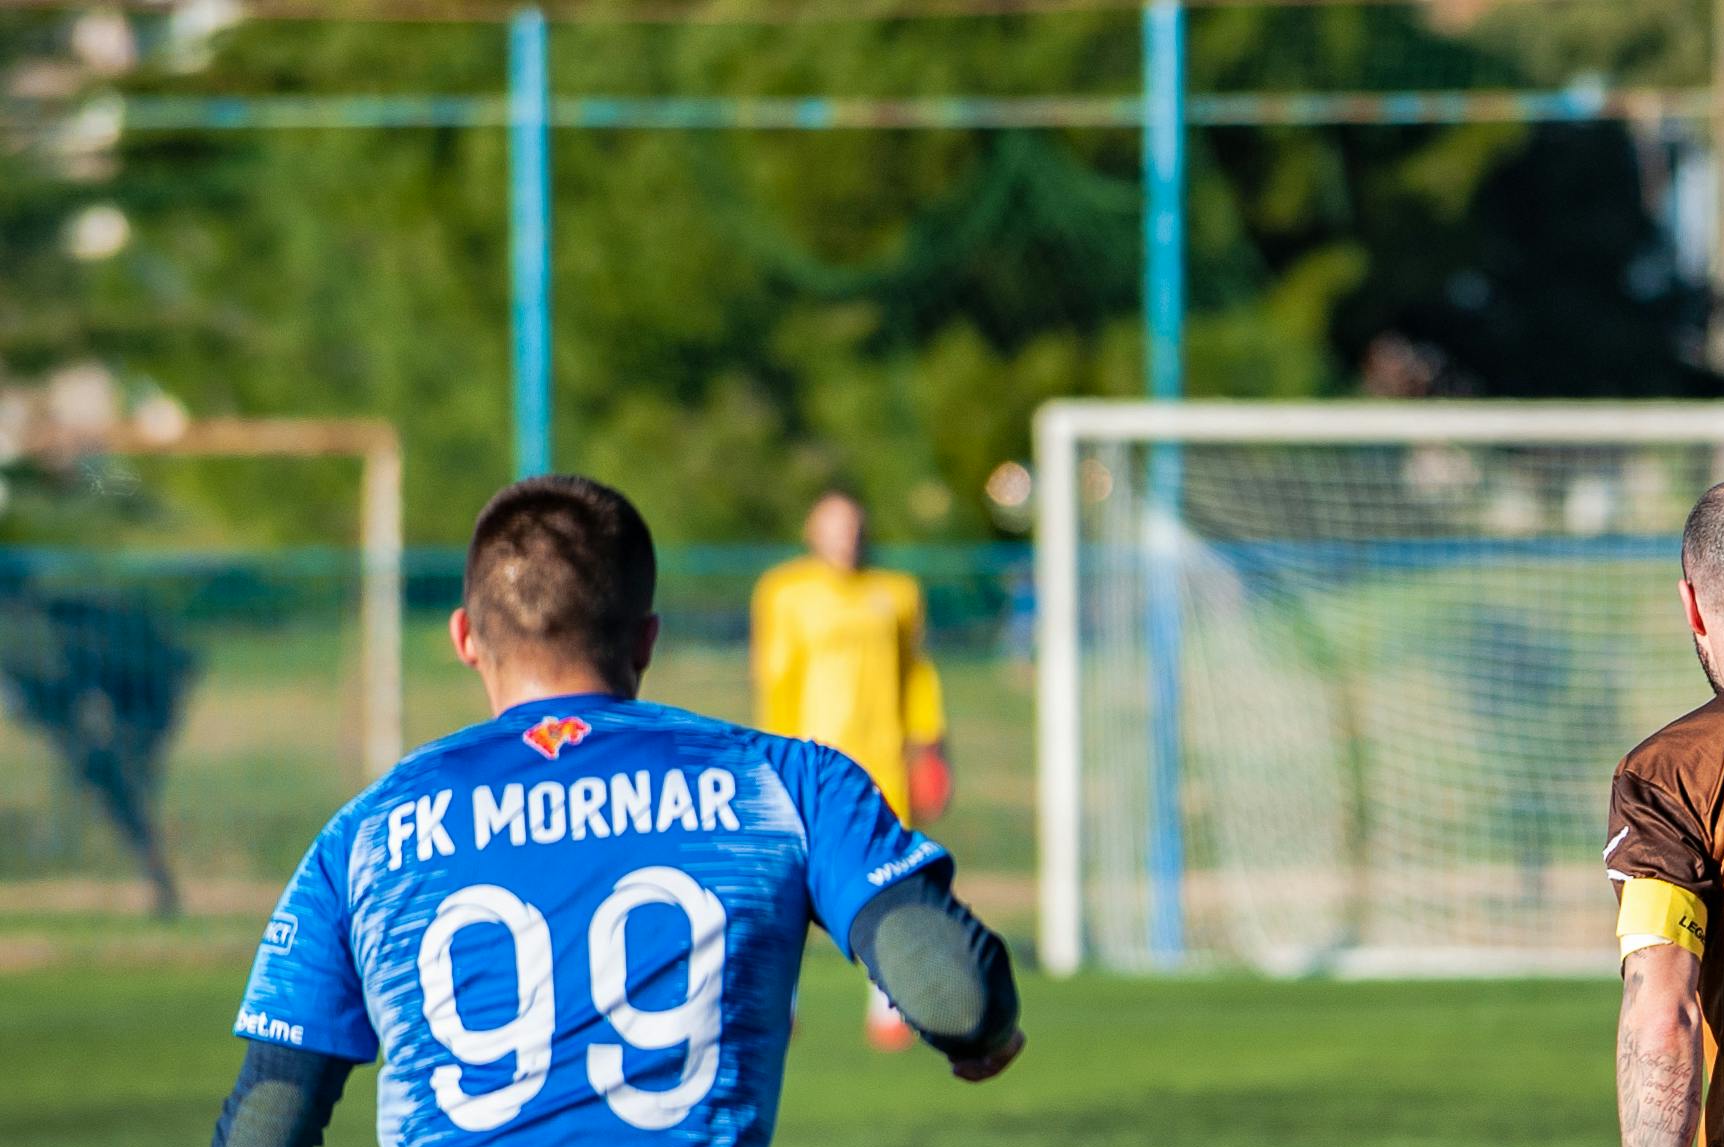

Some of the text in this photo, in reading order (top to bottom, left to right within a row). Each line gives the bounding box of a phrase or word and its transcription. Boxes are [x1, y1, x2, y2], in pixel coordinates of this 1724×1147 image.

[387, 767, 741, 872] FK MORNAR
[416, 865, 728, 1132] 99
